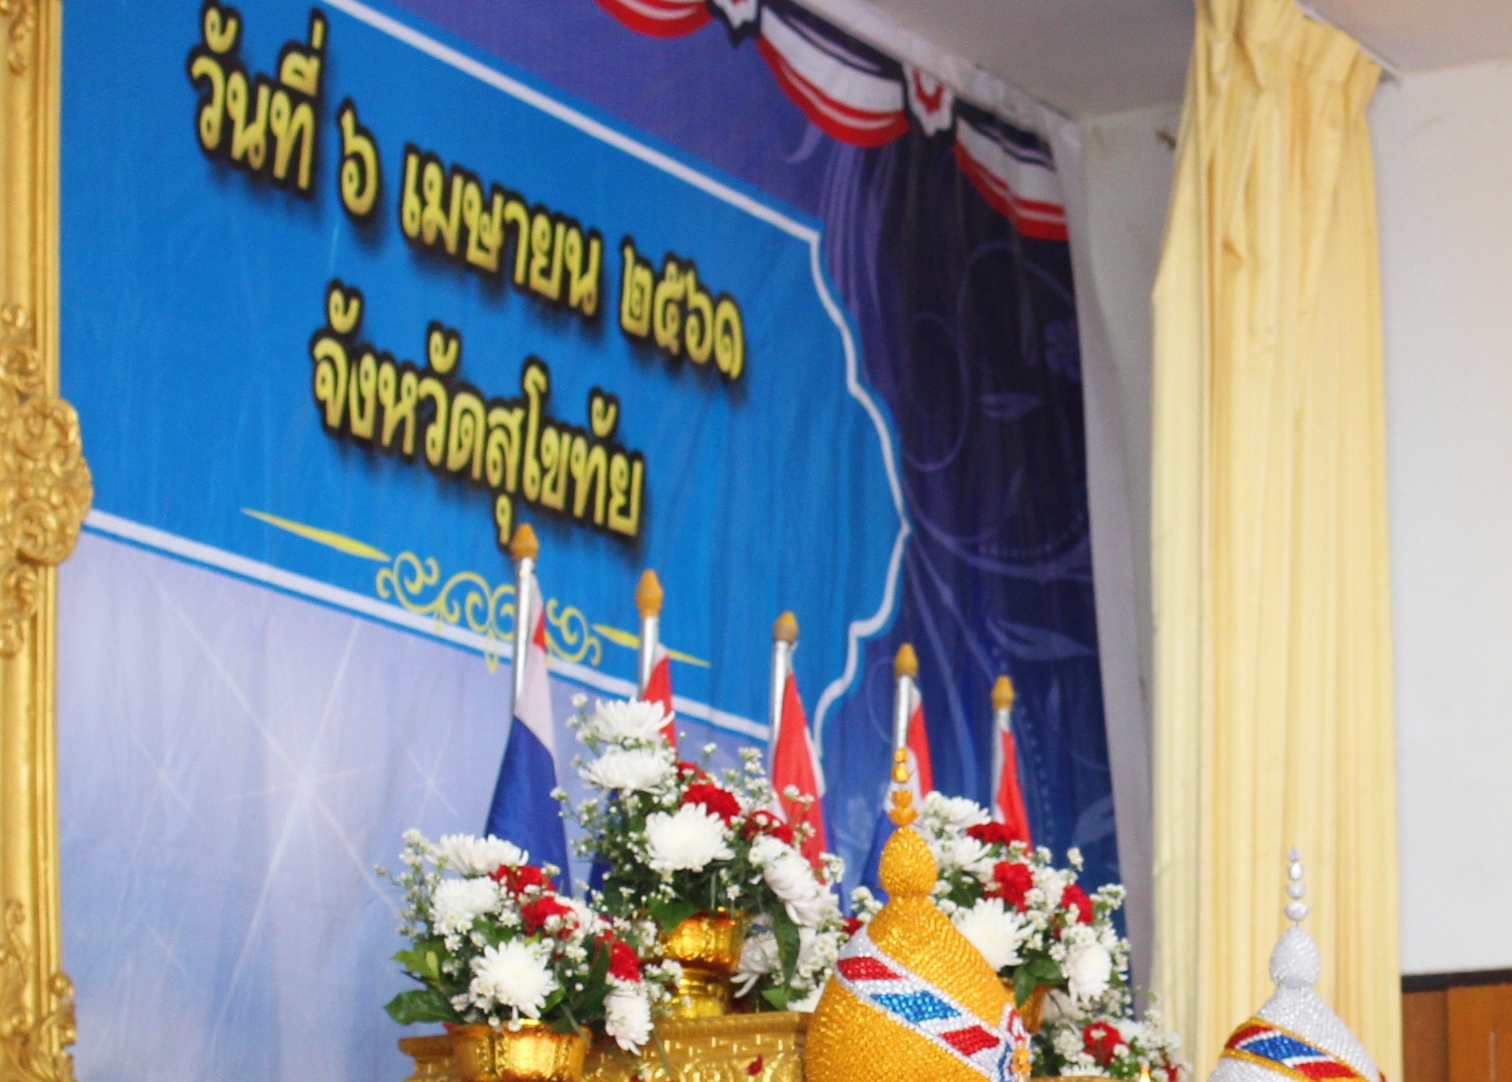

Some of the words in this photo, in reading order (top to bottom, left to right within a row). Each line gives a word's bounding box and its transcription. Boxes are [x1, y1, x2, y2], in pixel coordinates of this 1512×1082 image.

[189, 6, 324, 191] วันที่
[339, 108, 379, 216] ๖
[400, 152, 600, 317] เมษายน
[620, 244, 745, 380] ๒๕๖๑
[312, 288, 645, 546] จังหวัดสุโขทัย
